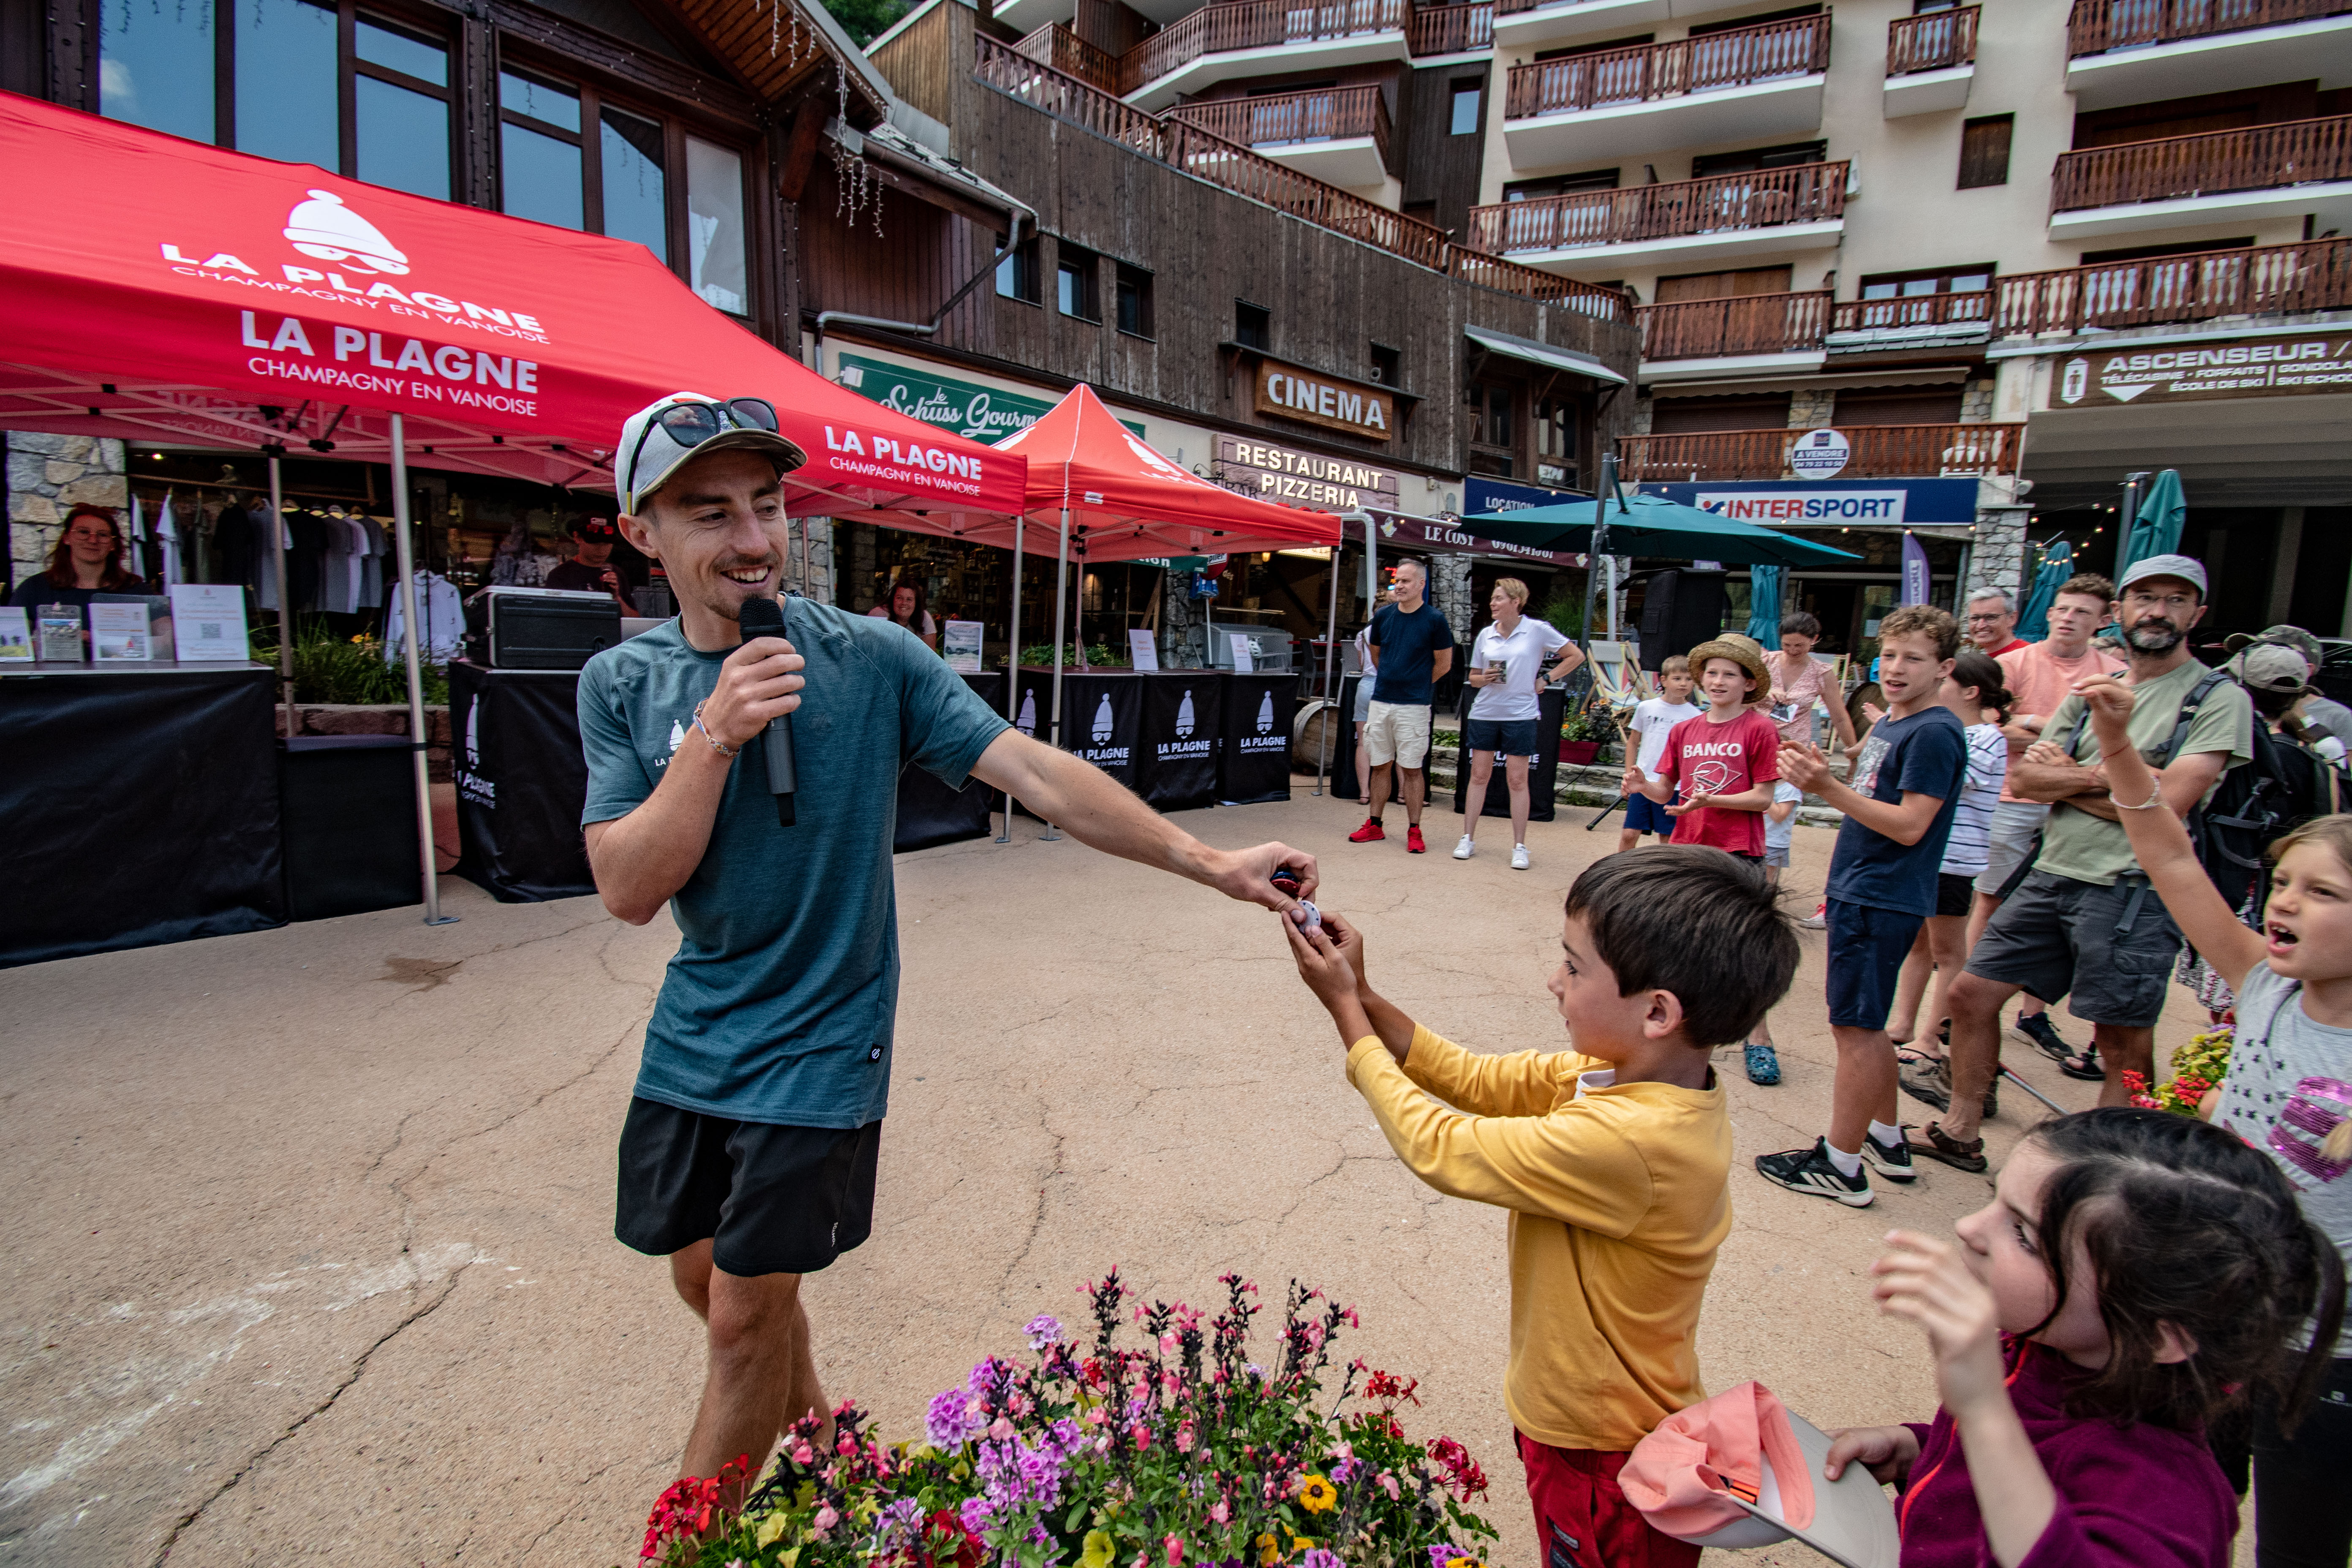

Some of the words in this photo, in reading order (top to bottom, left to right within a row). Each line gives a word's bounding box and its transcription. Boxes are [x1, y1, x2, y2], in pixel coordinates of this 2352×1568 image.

[160, 243, 259, 275] LA
[282, 265, 545, 333] PLAGNE
[171, 267, 379, 310] CHAMPAGNY
[389, 304, 429, 319] EN
[435, 313, 551, 345] VANOISE
[241, 310, 315, 357] LA
[335, 326, 538, 394] PLAGNE
[2102, 342, 2328, 373] ASCENSEUR
[248, 357, 404, 395] CHAMPAGNY
[411, 382, 442, 402] EN
[447, 388, 538, 416] VANOISE
[2100, 371, 2186, 384] TÉLÉCABINE
[2195, 365, 2267, 378] FORFAITS
[2169, 381, 2217, 392] ÉCOLE
[2218, 379, 2239, 389] DE
[2239, 378, 2265, 388] SKI
[2276, 376, 2303, 386] SKI
[879, 385, 962, 423] Schuss
[925, 387, 948, 405] Le
[1267, 373, 1386, 430] CINEMA
[825, 426, 865, 455] LA
[873, 436, 982, 480] PLAGNE
[1805, 450, 1845, 458] VENDRE
[830, 457, 911, 483] CHAMPAGNY
[915, 473, 931, 486] EN
[934, 477, 980, 496] VANOISE
[1236, 443, 1383, 489] RESTAURANT
[1261, 473, 1359, 508] PIZZERIA
[1728, 498, 1896, 518] INTERSPORT
[1425, 526, 1443, 542] LE
[1086, 748, 1129, 760] PLAGNE
[1157, 743, 1169, 754] LA
[1171, 740, 1211, 753] PLAGNE
[1241, 738, 1251, 747] LA
[1252, 736, 1286, 746] PLAGNE
[1683, 742, 1742, 758] BANCO
[655, 758, 666, 766] LA
